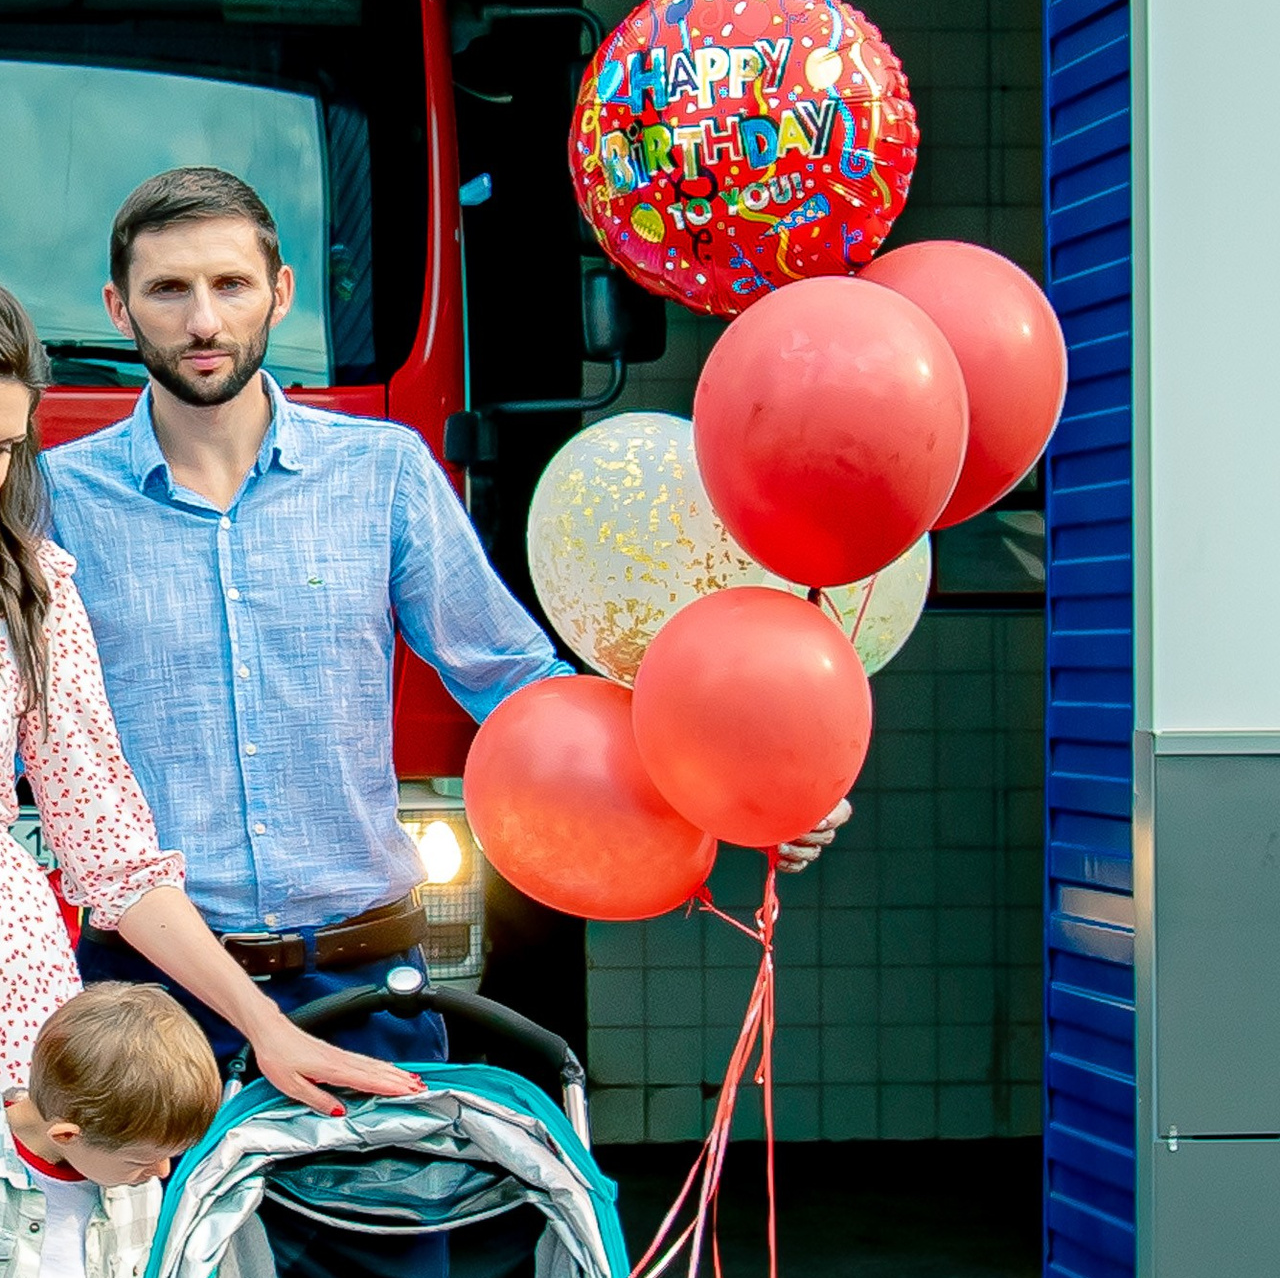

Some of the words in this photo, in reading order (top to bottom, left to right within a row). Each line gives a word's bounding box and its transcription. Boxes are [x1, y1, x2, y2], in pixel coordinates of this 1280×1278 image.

[626, 37, 793, 114] HAPPY
[667, 196, 713, 231] TO
[719, 171, 806, 217] YOU!
